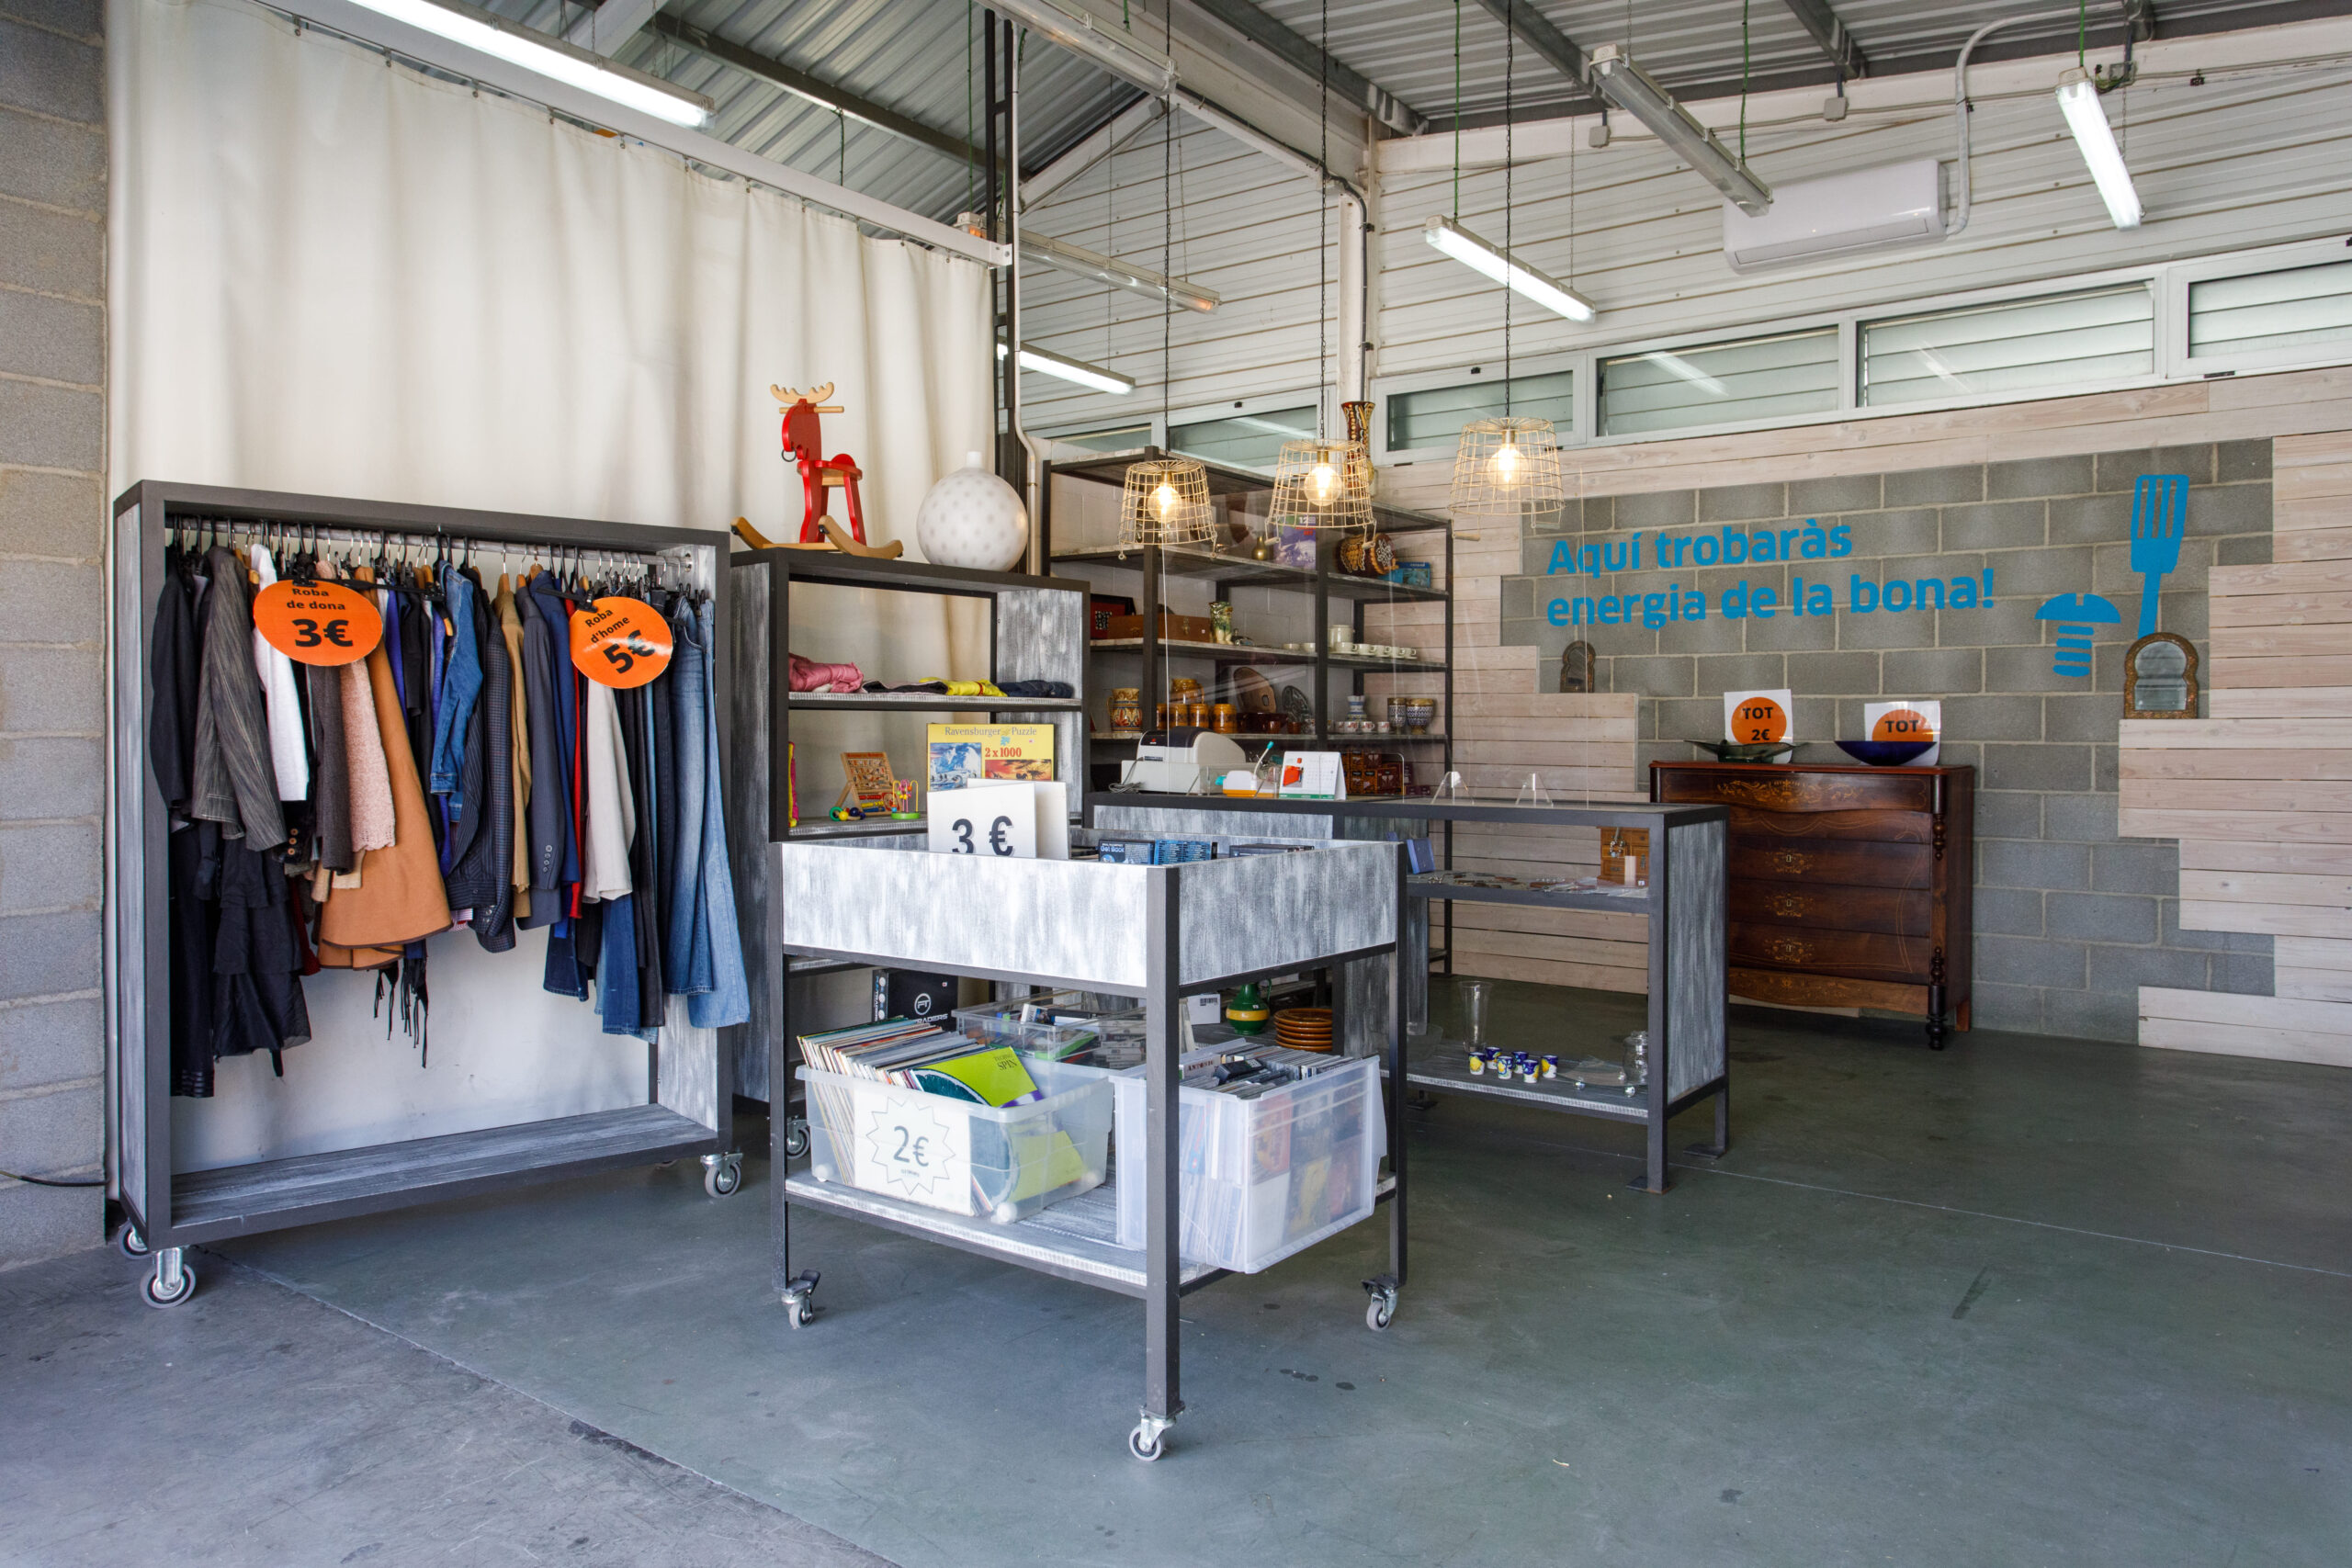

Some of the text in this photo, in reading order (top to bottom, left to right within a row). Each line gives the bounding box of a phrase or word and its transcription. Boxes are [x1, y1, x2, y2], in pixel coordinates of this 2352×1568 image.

[1547, 519, 1852, 579] Aquí trobaràs
[291, 588, 329, 597] Roba
[1547, 568, 1995, 631] energia de la bona!
[287, 600, 346, 610] de dona
[584, 609, 614, 627] Roba
[292, 618, 354, 648] 3€
[590, 616, 630, 643] d'home
[603, 629, 656, 674] 5€
[1742, 706, 1774, 720] TOT
[944, 727, 1037, 737] Ravensburger Puzzle
[1885, 719, 1919, 733] TOT
[1751, 728, 1770, 741] 2€
[985, 748, 990, 758] 2
[1000, 747, 1022, 758] 1000
[893, 1125, 929, 1168] 2€
